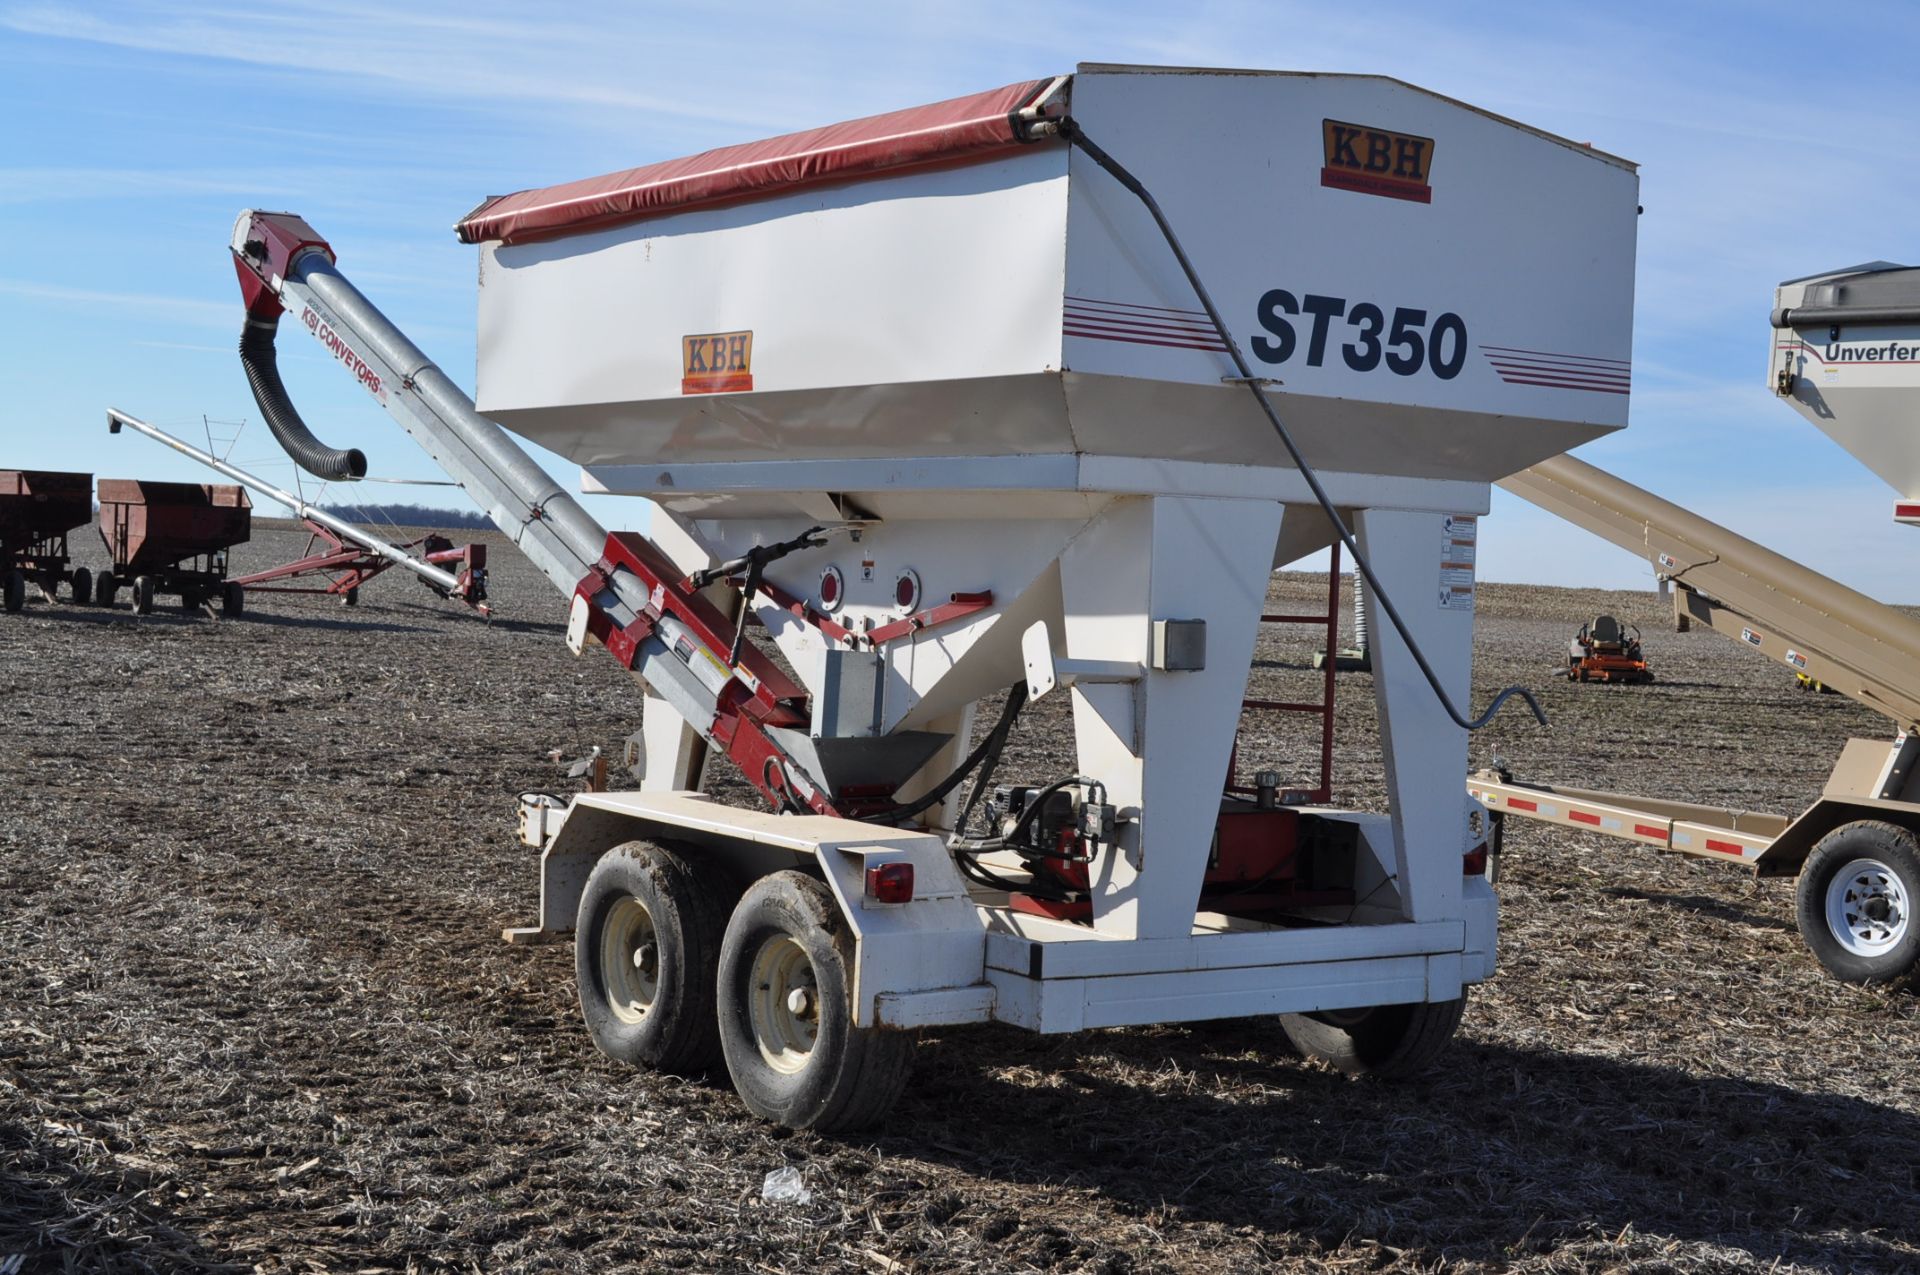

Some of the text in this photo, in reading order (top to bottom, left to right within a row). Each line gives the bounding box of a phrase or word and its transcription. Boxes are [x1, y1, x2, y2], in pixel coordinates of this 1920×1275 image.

[1331, 125, 1425, 178] KBH
[302, 306, 320, 331] KSI
[319, 324, 381, 393] CONVEYORS
[688, 335, 747, 372] KBH
[1251, 289, 1467, 380] ST350
